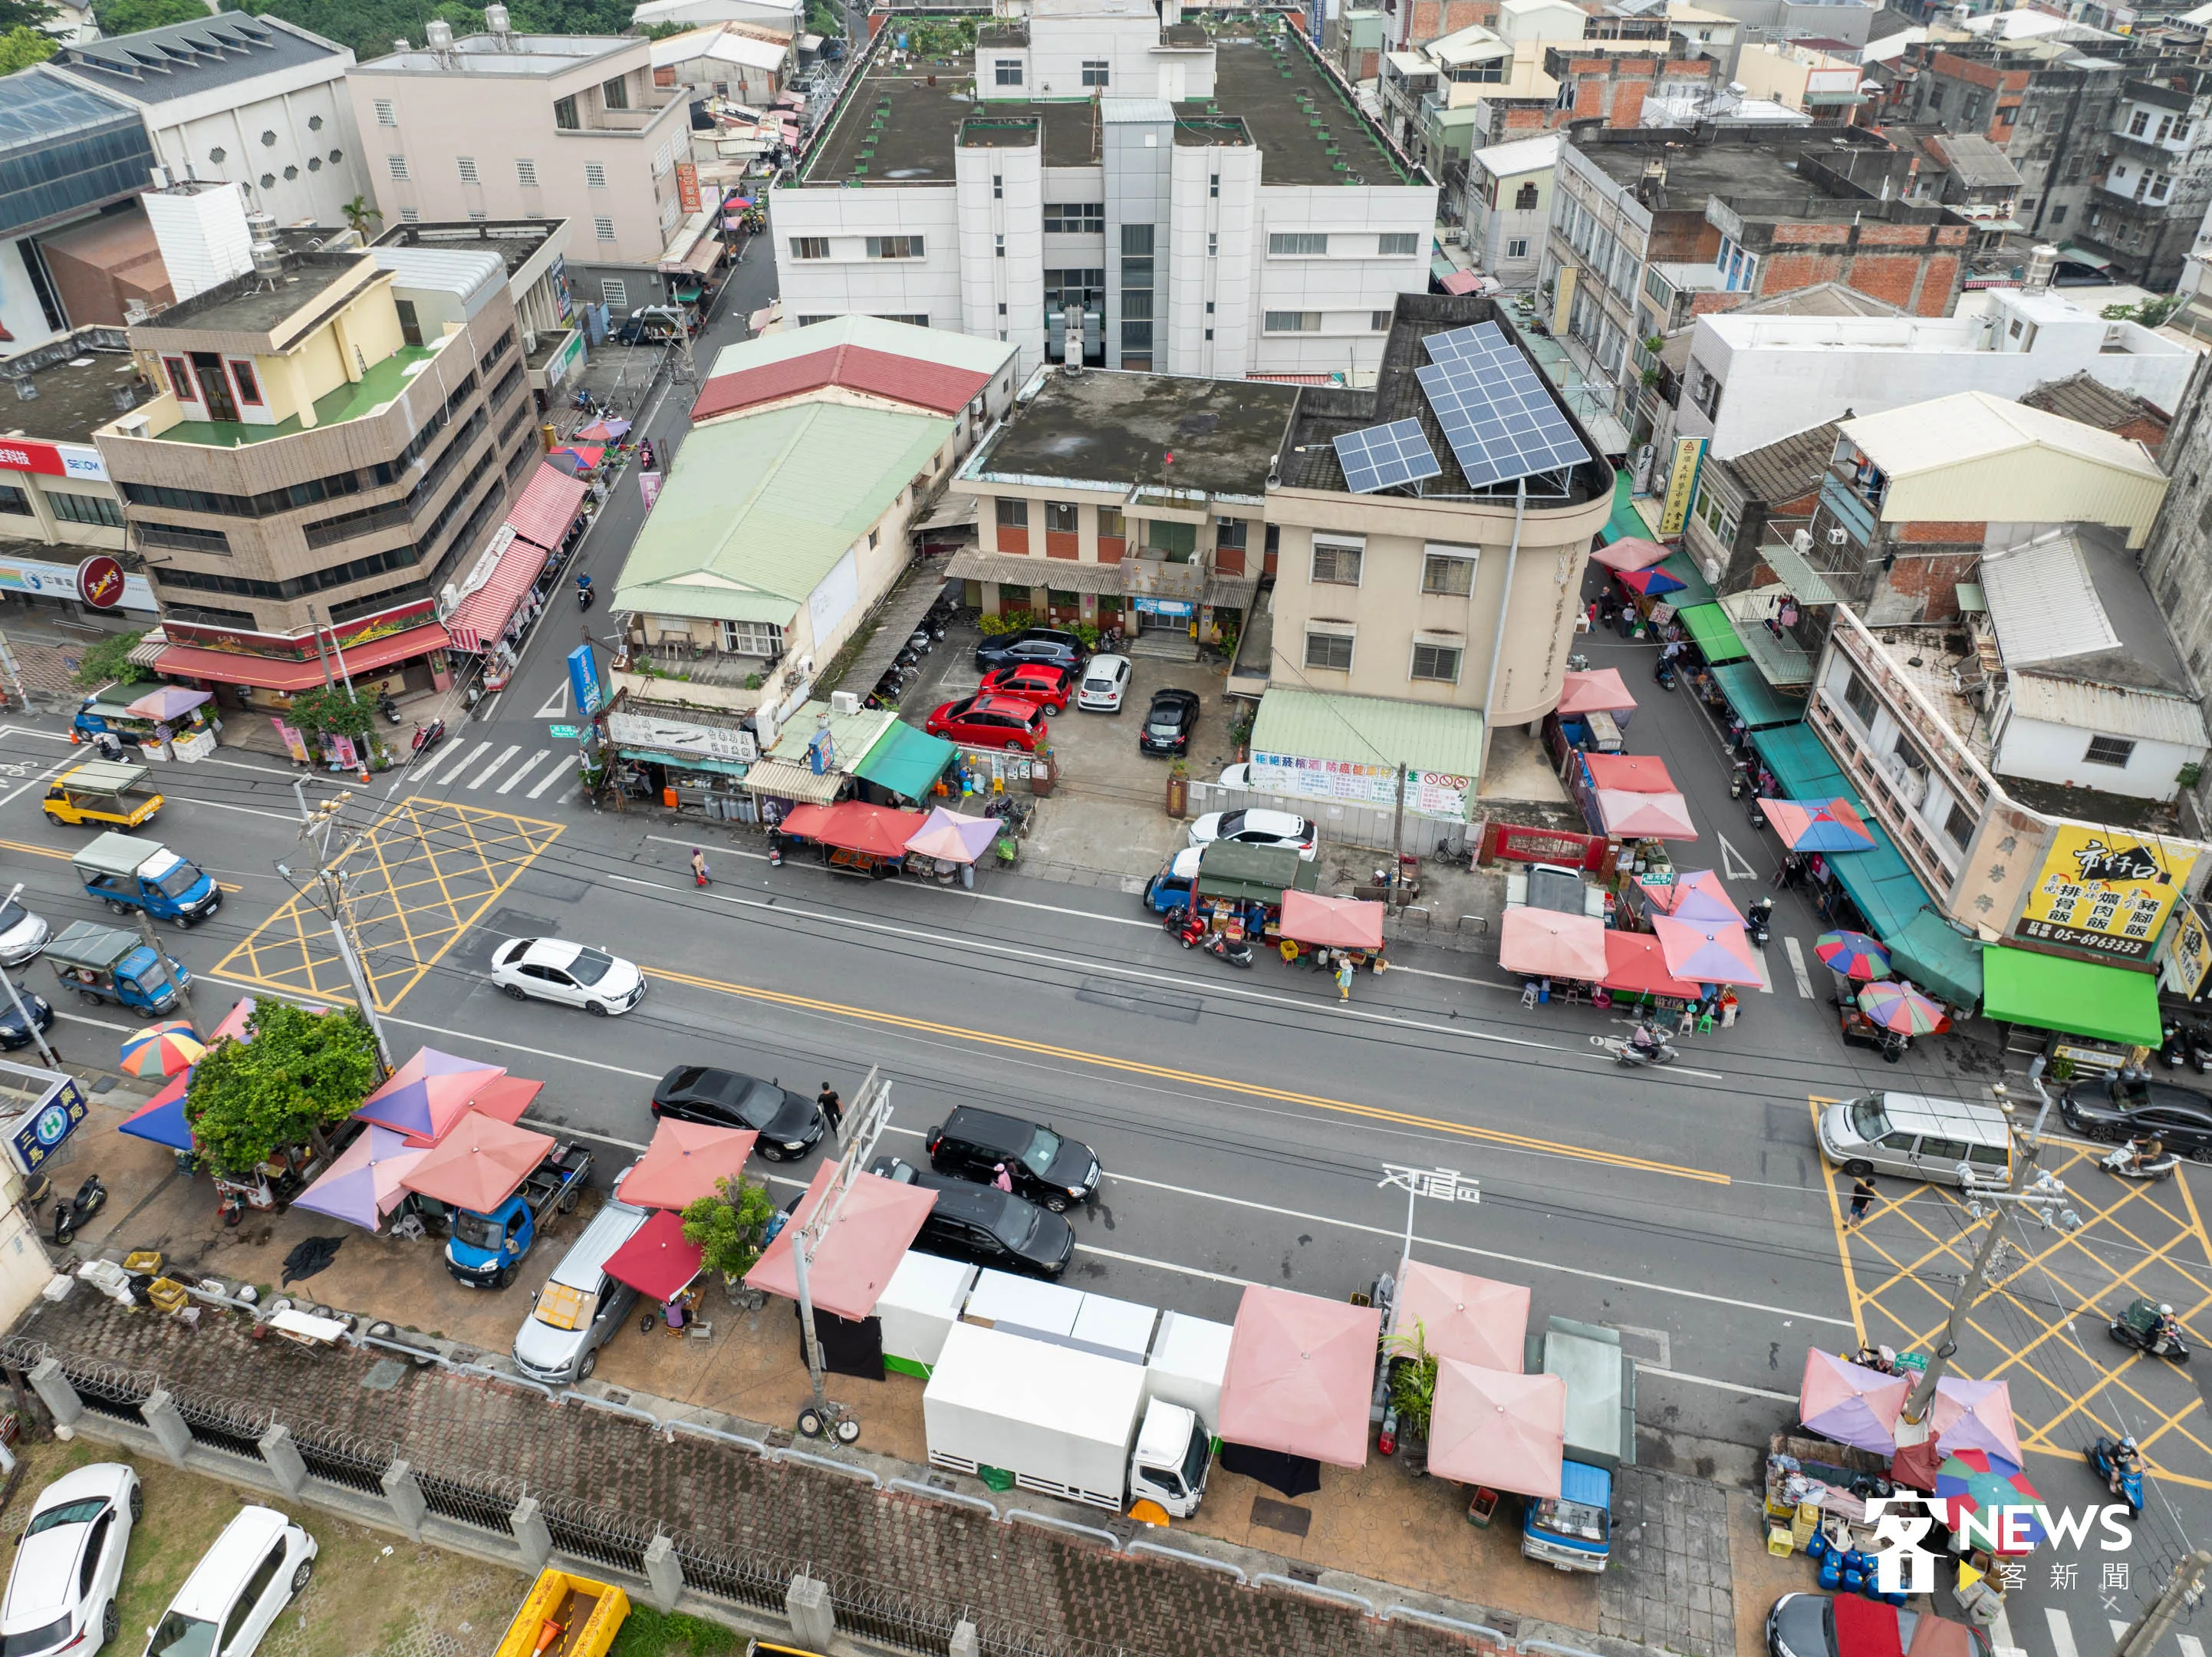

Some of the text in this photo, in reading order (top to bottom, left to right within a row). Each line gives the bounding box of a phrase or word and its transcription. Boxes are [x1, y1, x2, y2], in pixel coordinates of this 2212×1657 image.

[67, 459, 100, 472] SECOM
[1255, 753, 1418, 782] 拒絕菸檳酒 防癌健康好生
[2073, 838, 2158, 881] 市仔口
[2048, 884, 2082, 924] 排骨飯
[2054, 927, 2143, 954] 05-6963333
